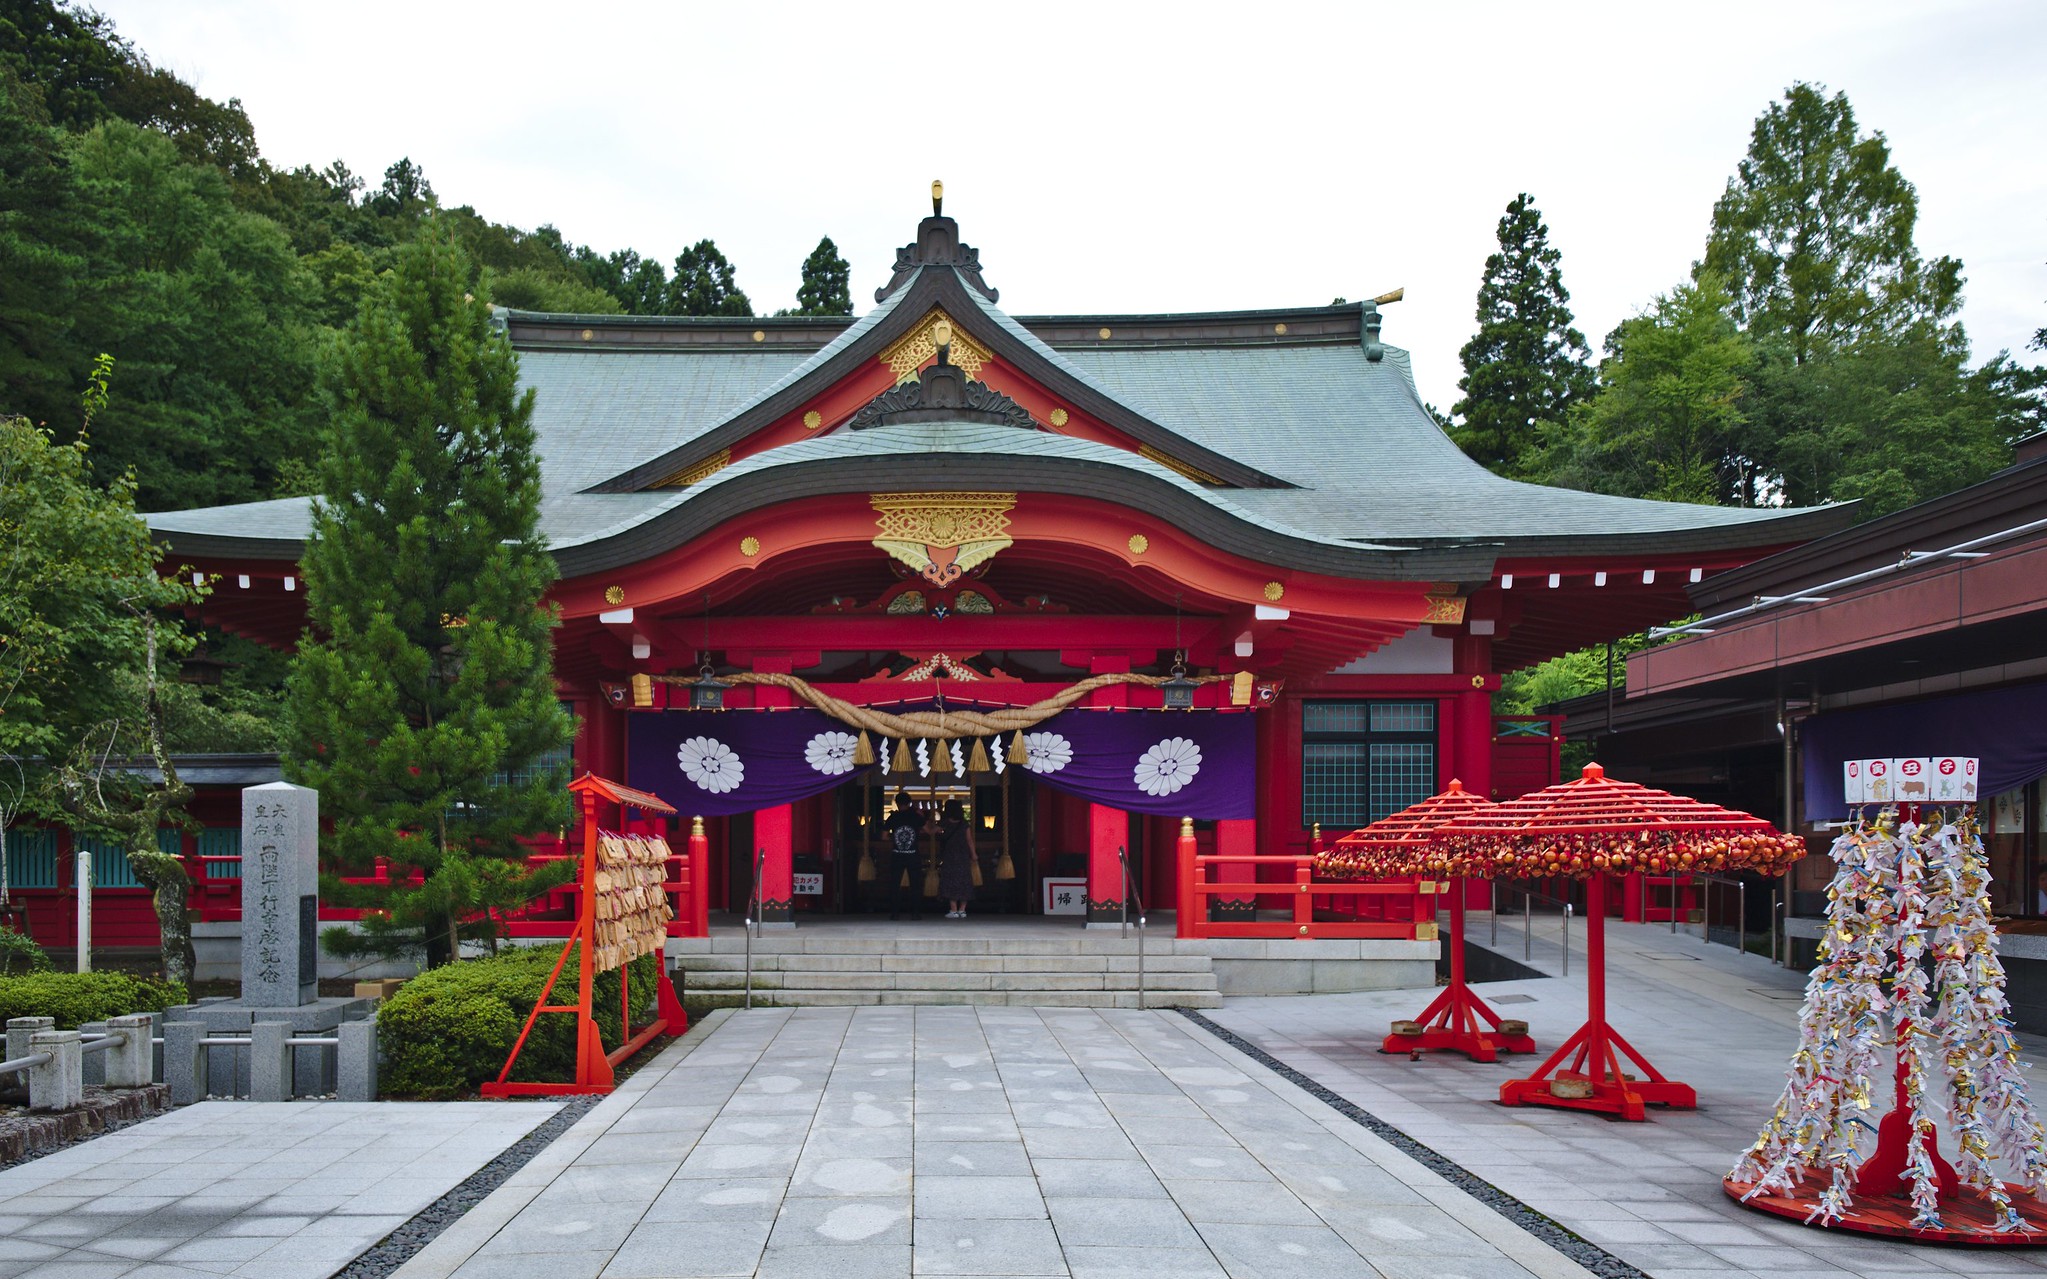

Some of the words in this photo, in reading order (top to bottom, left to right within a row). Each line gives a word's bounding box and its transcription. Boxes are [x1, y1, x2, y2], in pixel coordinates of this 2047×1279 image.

[1871, 762, 1885, 775] 寅
[1904, 762, 1919, 774] 丑
[1941, 761, 1954, 772] 子
[253, 804, 269, 837] 皇后
[272, 803, 287, 836] 天皇
